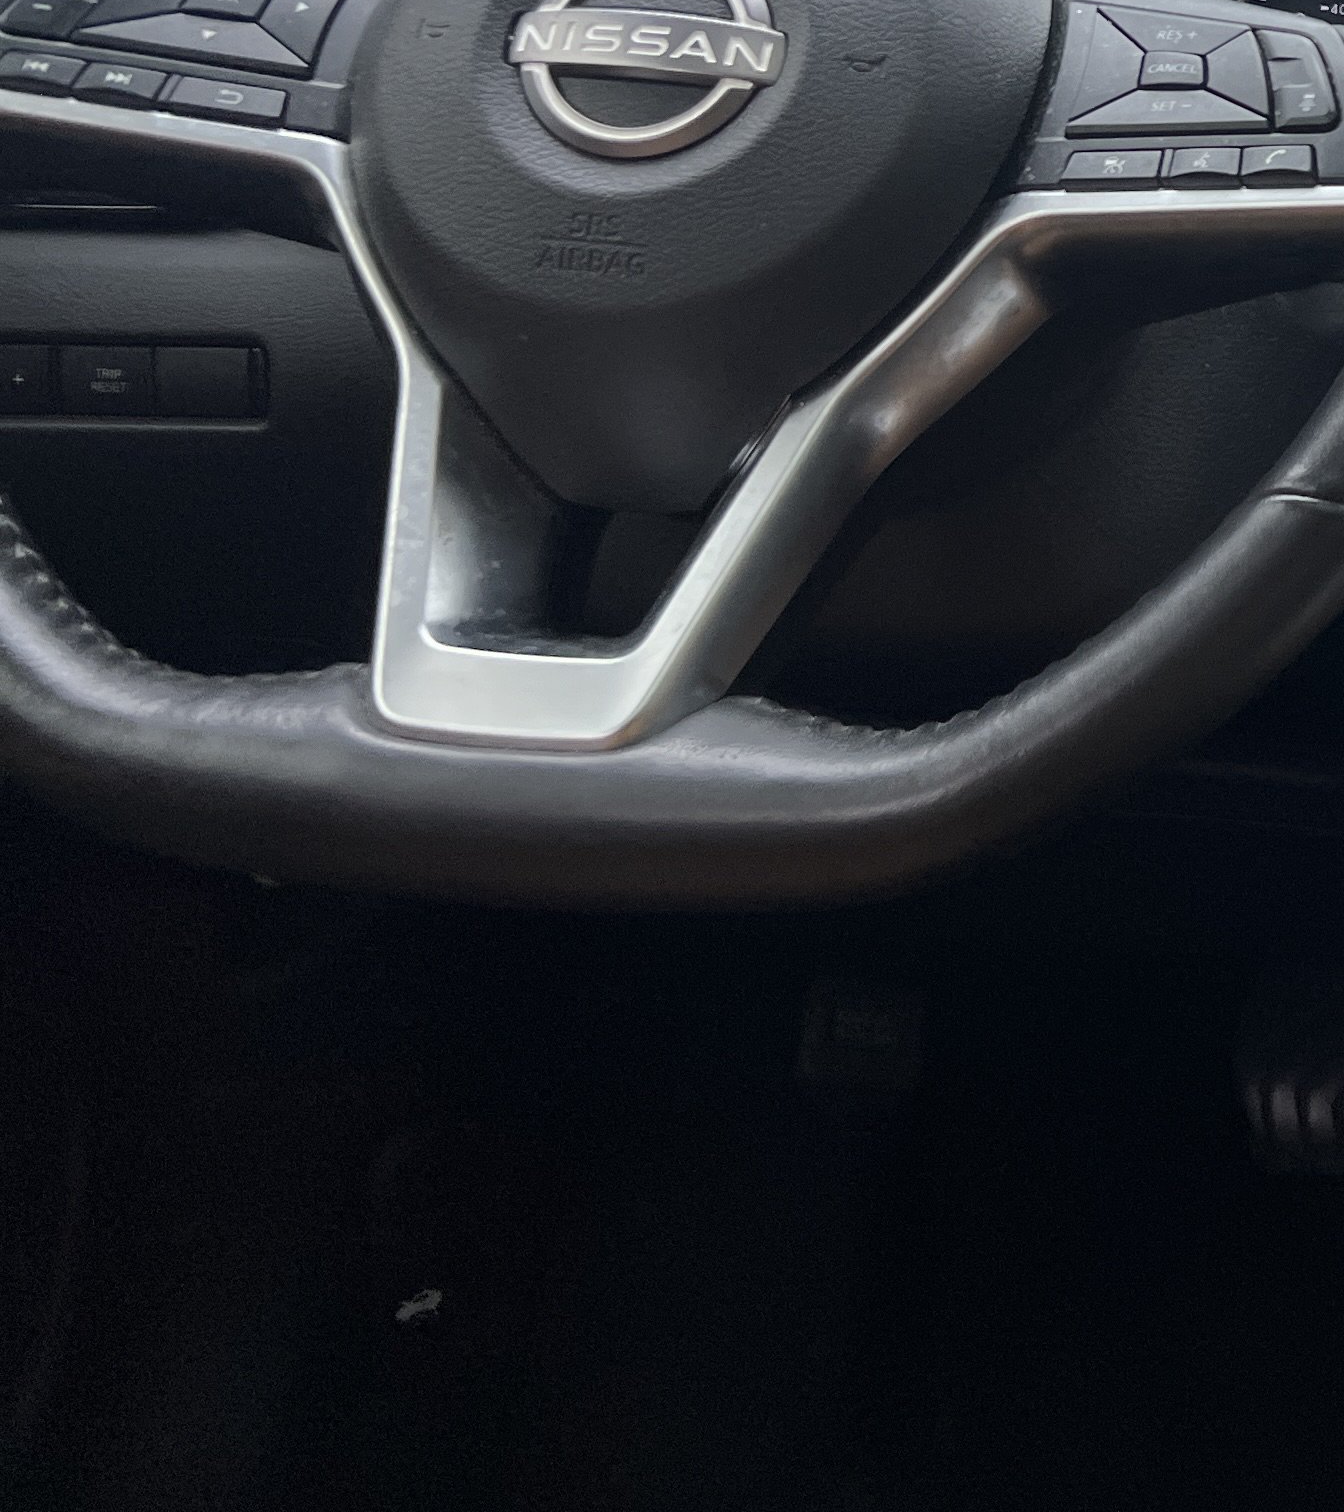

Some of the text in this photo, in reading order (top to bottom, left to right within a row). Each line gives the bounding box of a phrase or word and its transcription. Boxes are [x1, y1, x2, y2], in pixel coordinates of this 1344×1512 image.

[515, 21, 774, 74] NISSAN
[1147, 62, 1199, 75] CANCEL
[1150, 99, 1177, 113] SET
